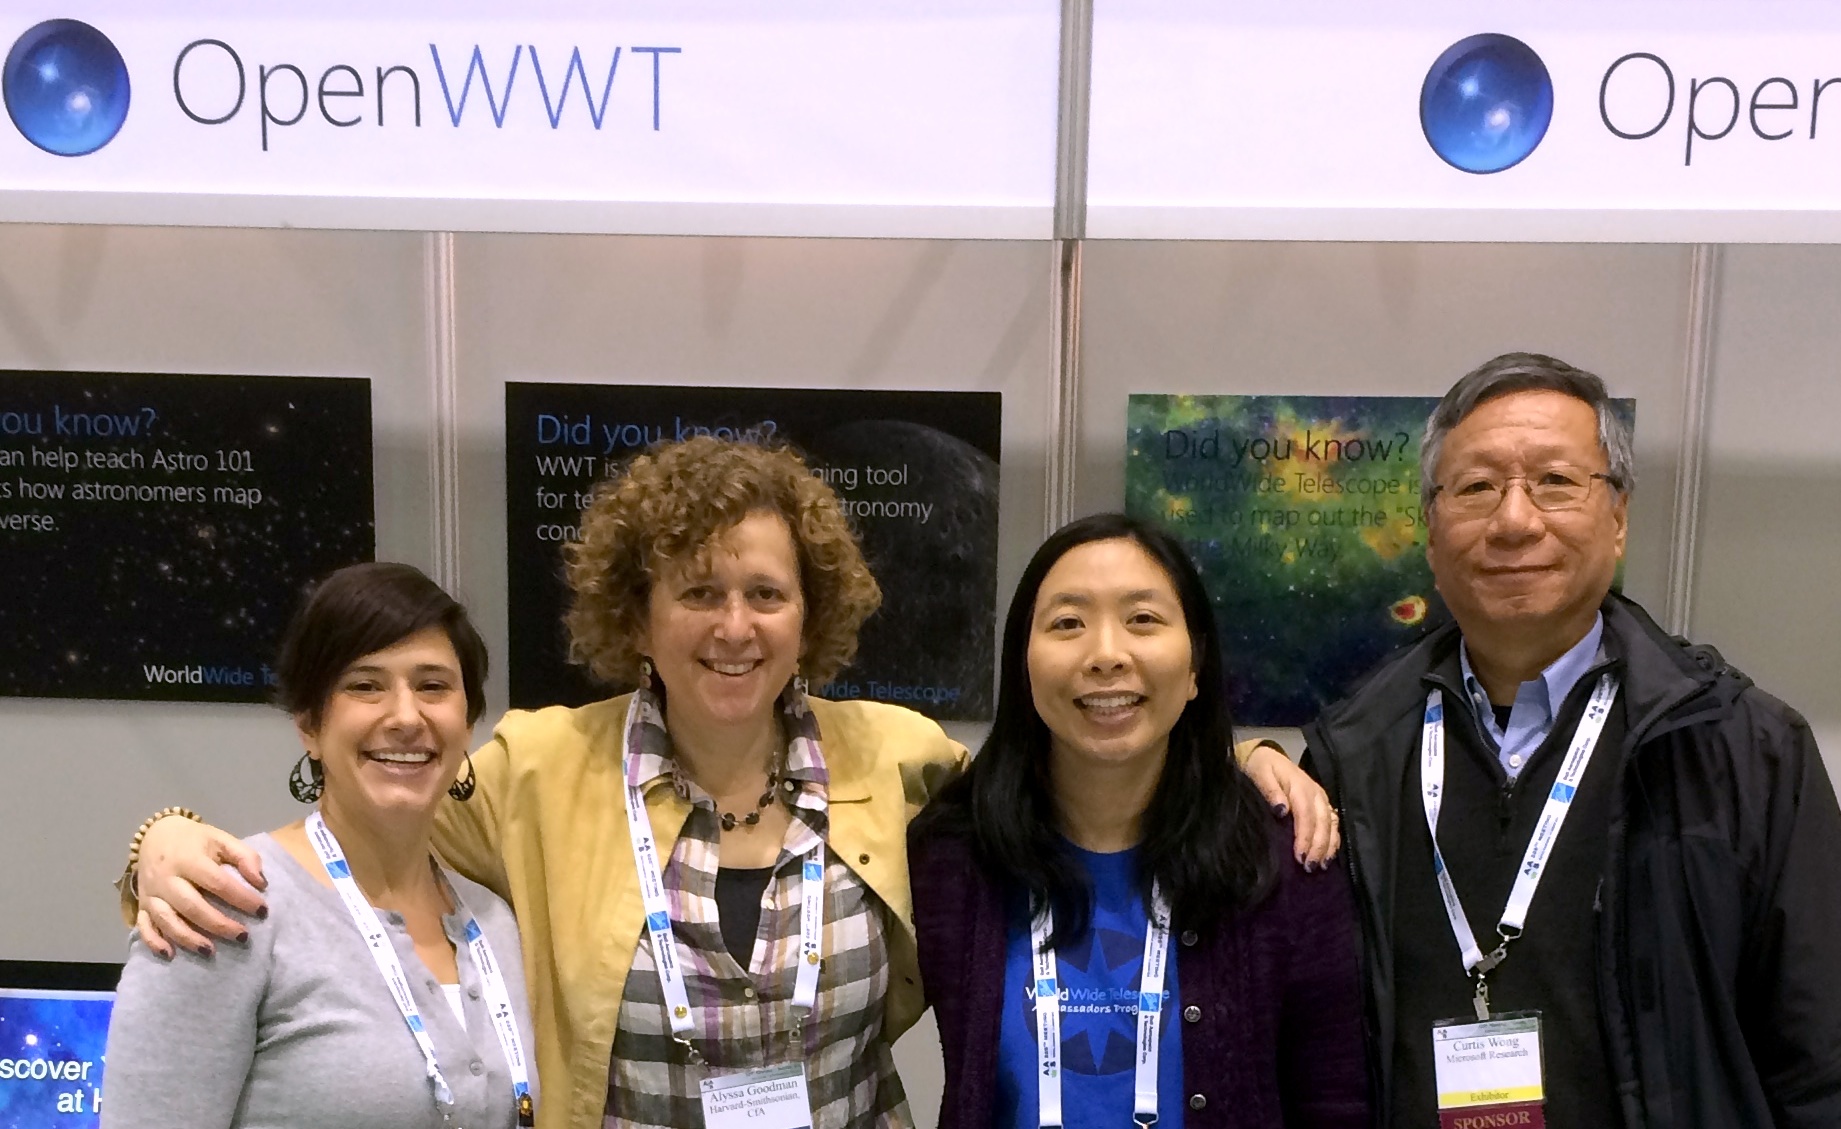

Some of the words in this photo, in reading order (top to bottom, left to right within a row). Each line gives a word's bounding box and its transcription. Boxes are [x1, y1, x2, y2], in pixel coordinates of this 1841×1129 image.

[173, 38, 682, 151] OpenWWT
[54, 404, 157, 436] know?
[537, 414, 591, 445] Did
[602, 421, 661, 454] you
[32, 446, 79, 474] help
[85, 448, 145, 470] teach
[152, 449, 208, 472] Astro
[215, 449, 255, 472] 101
[1165, 430, 1219, 461] Did
[1232, 436, 1291, 468] you
[1306, 429, 1410, 462] know?
[535, 455, 596, 477] WWT
[604, 457, 618, 479] is
[866, 463, 908, 485] tool
[19, 477, 64, 500] how
[72, 481, 206, 503] astronomers
[213, 486, 262, 509] map
[1294, 471, 1401, 499] Telescope
[536, 486, 567, 509] for
[1251, 508, 1301, 532] map
[1307, 507, 1346, 526] out
[1352, 505, 1388, 527] the
[867, 680, 961, 704] Telescope
[1032, 1004, 1112, 1014] assadors
[1446, 1053, 1486, 1063] Microsoft
[1489, 1048, 1529, 1060] Research
[1453, 1039, 1485, 1051] Curtis
[1488, 1036, 1520, 1049] Wong
[57, 1088, 84, 1113] at
[710, 1088, 745, 1103] Alyssa
[746, 1079, 798, 1096] Goodman
[1470, 1090, 1509, 1102] Exhibitor
[1453, 1111, 1531, 1129] SPONSOR
